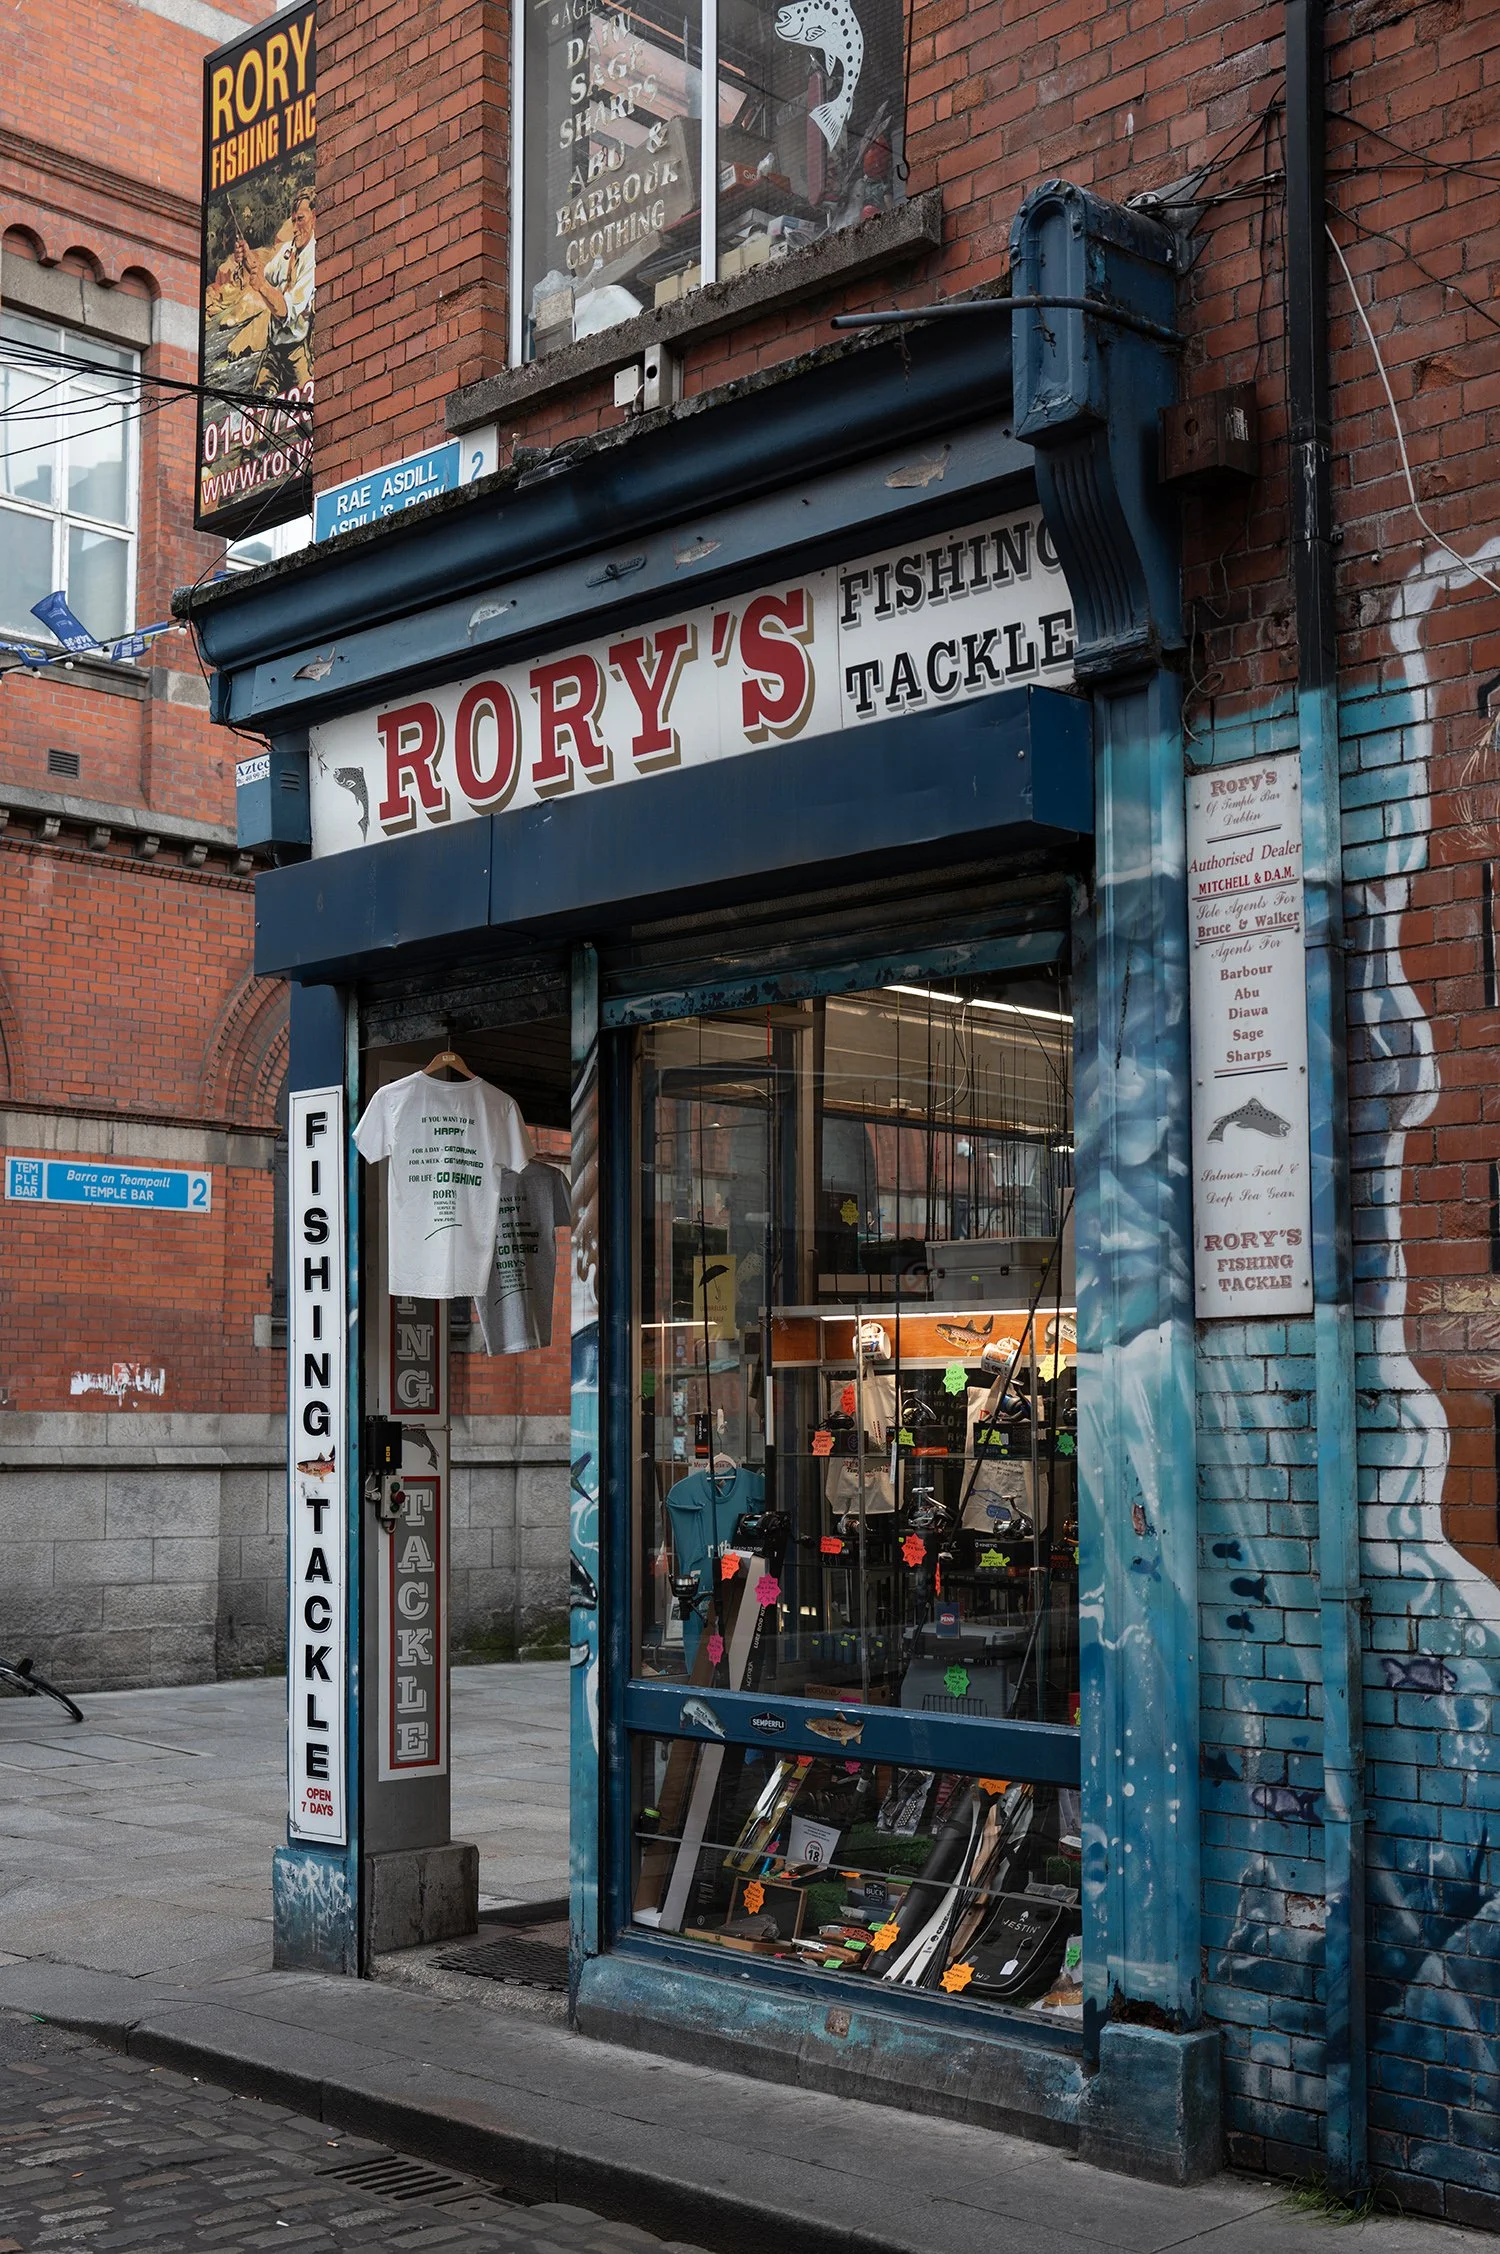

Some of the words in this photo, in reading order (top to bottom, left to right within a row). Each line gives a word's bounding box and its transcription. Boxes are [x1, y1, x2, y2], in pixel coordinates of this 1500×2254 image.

[211, 12, 316, 142] RORY
[210, 113, 280, 192] FISHING
[565, 199, 665, 271] CLOTHING
[336, 485, 371, 517] RAE
[381, 461, 438, 500] ASDILL
[845, 608, 1077, 715] TACKLE
[376, 587, 813, 832] RORY'S
[1210, 770, 1278, 797] Rory's
[1221, 796, 1256, 817] Temple
[1260, 790, 1281, 802] Bar
[1223, 811, 1263, 826] Dublin
[1188, 848, 1255, 874] Authorised
[1261, 840, 1302, 860] Dealer
[1199, 873, 1251, 895] MITCHELL
[1253, 871, 1262, 885] &
[1264, 866, 1296, 884] D.A.M.
[1224, 898, 1269, 919] Agents
[1273, 890, 1297, 905] For
[1197, 923, 1232, 938] Bruce
[1238, 918, 1248, 931] &
[1255, 911, 1301, 928] Walker
[1211, 941, 1255, 963] Agents
[1259, 934, 1284, 950] For
[1220, 963, 1273, 982] Barbour
[1234, 988, 1261, 1001] Abu
[1228, 1005, 1269, 1020] Diawa
[1232, 1028, 1265, 1043] Sage
[1226, 1048, 1272, 1064] Sharps
[433, 1127, 465, 1137] HAPPY
[15, 1161, 39, 1174] TEM
[67, 1169, 98, 1183] Barra
[101, 1173, 115, 1184] an
[436, 1171, 450, 1183] GO
[15, 1173, 39, 1186] PLE
[15, 1185, 38, 1197] BAR
[83, 1185, 128, 1200] TEMPLE
[131, 1188, 154, 1202] BAR
[192, 1177, 207, 1207] 2
[1205, 1191, 1233, 1209] Deep
[1238, 1188, 1261, 1203] Sea
[499, 1205, 521, 1214] APPY
[1203, 1228, 1303, 1252] RORY'S
[1217, 1253, 1294, 1273] FISHING
[302, 1111, 331, 1437] FISHING
[1218, 1274, 1293, 1293] TACKLE
[397, 1489, 435, 1760] TACKLE
[304, 1498, 333, 1781] TACKLE
[306, 1787, 332, 1802] OPEN
[301, 1801, 307, 1812] 7
[309, 1803, 334, 1817] DAYS
[808, 1849, 821, 1863] 18
[865, 1886, 884, 1898] BUCK
